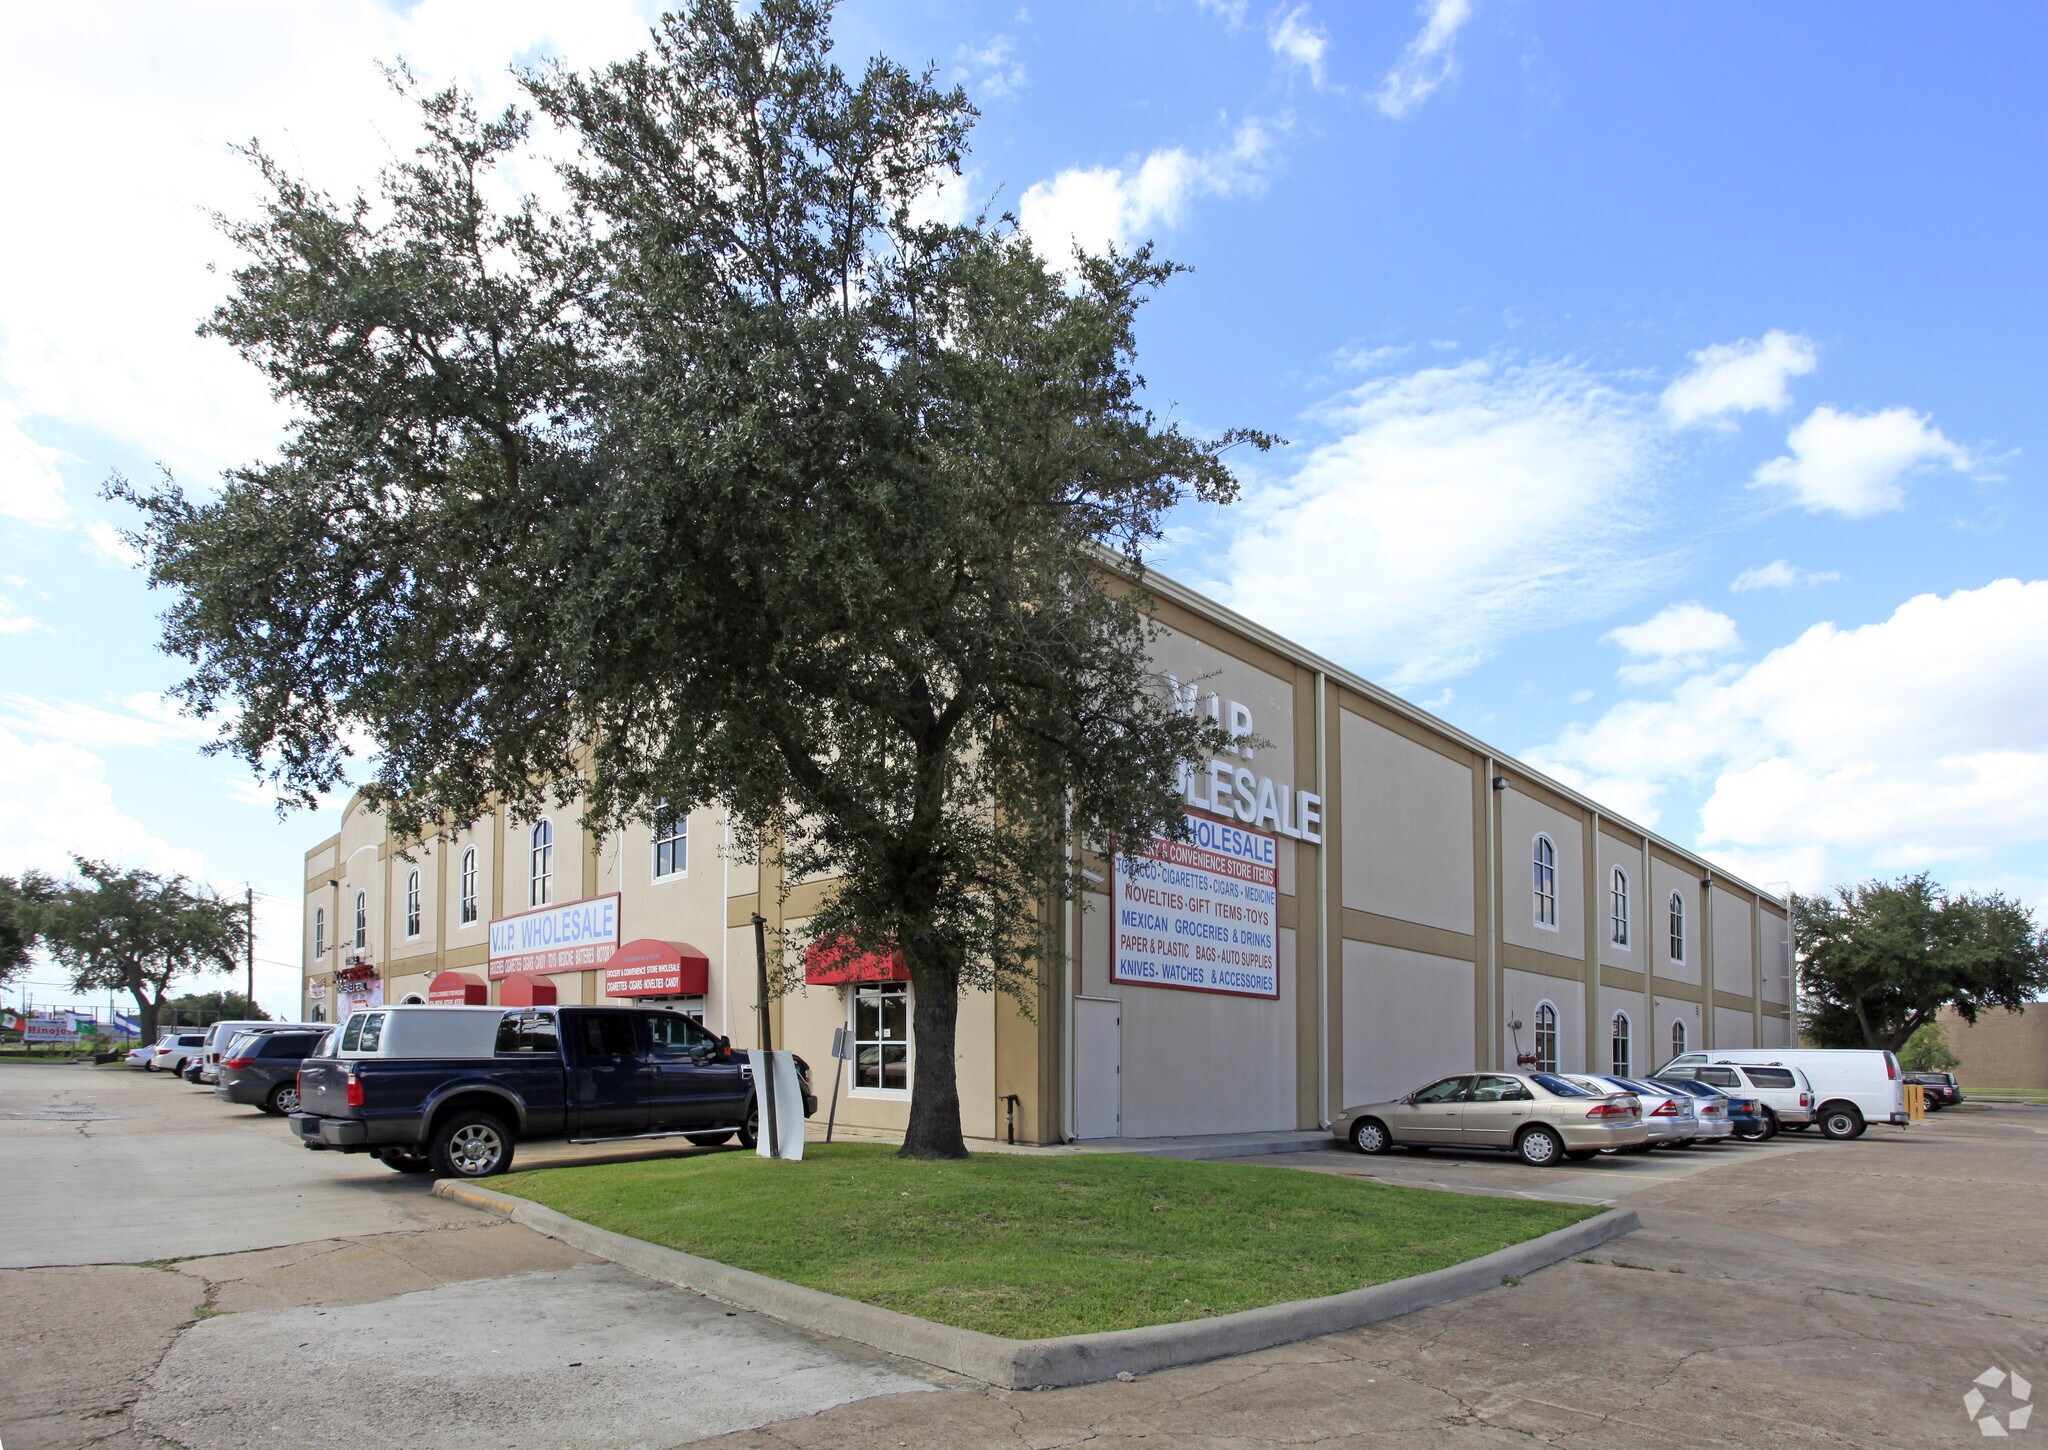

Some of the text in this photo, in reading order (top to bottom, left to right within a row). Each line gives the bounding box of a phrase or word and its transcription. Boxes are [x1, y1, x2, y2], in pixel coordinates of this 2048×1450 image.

[1176, 814, 1273, 864] HOLESALE
[1170, 845, 1226, 873] CONVENIENCE
[1227, 860, 1252, 879] STORE
[1253, 865, 1274, 885] ITEMS
[1125, 883, 1269, 926] NOVELTIES GIFT ITEMS TOYS
[1162, 868, 1208, 891] CIGARETTES
[1213, 878, 1239, 898] CIGARS
[1245, 886, 1275, 905] MEDICINE
[491, 903, 613, 953] V.I.P. WHOLESALE
[1122, 909, 1272, 949] MEXICAN GROCERIES & DRINKS
[646, 964, 658, 974] STORE
[658, 963, 680, 973] WHOLESALE
[1120, 934, 1273, 970] PAPER & PLASTIC BAGS AUTO SUPPLIES
[665, 976, 679, 988] CANDY
[1120, 958, 1273, 991] KNIVES WATCHES & ACCESSORIES
